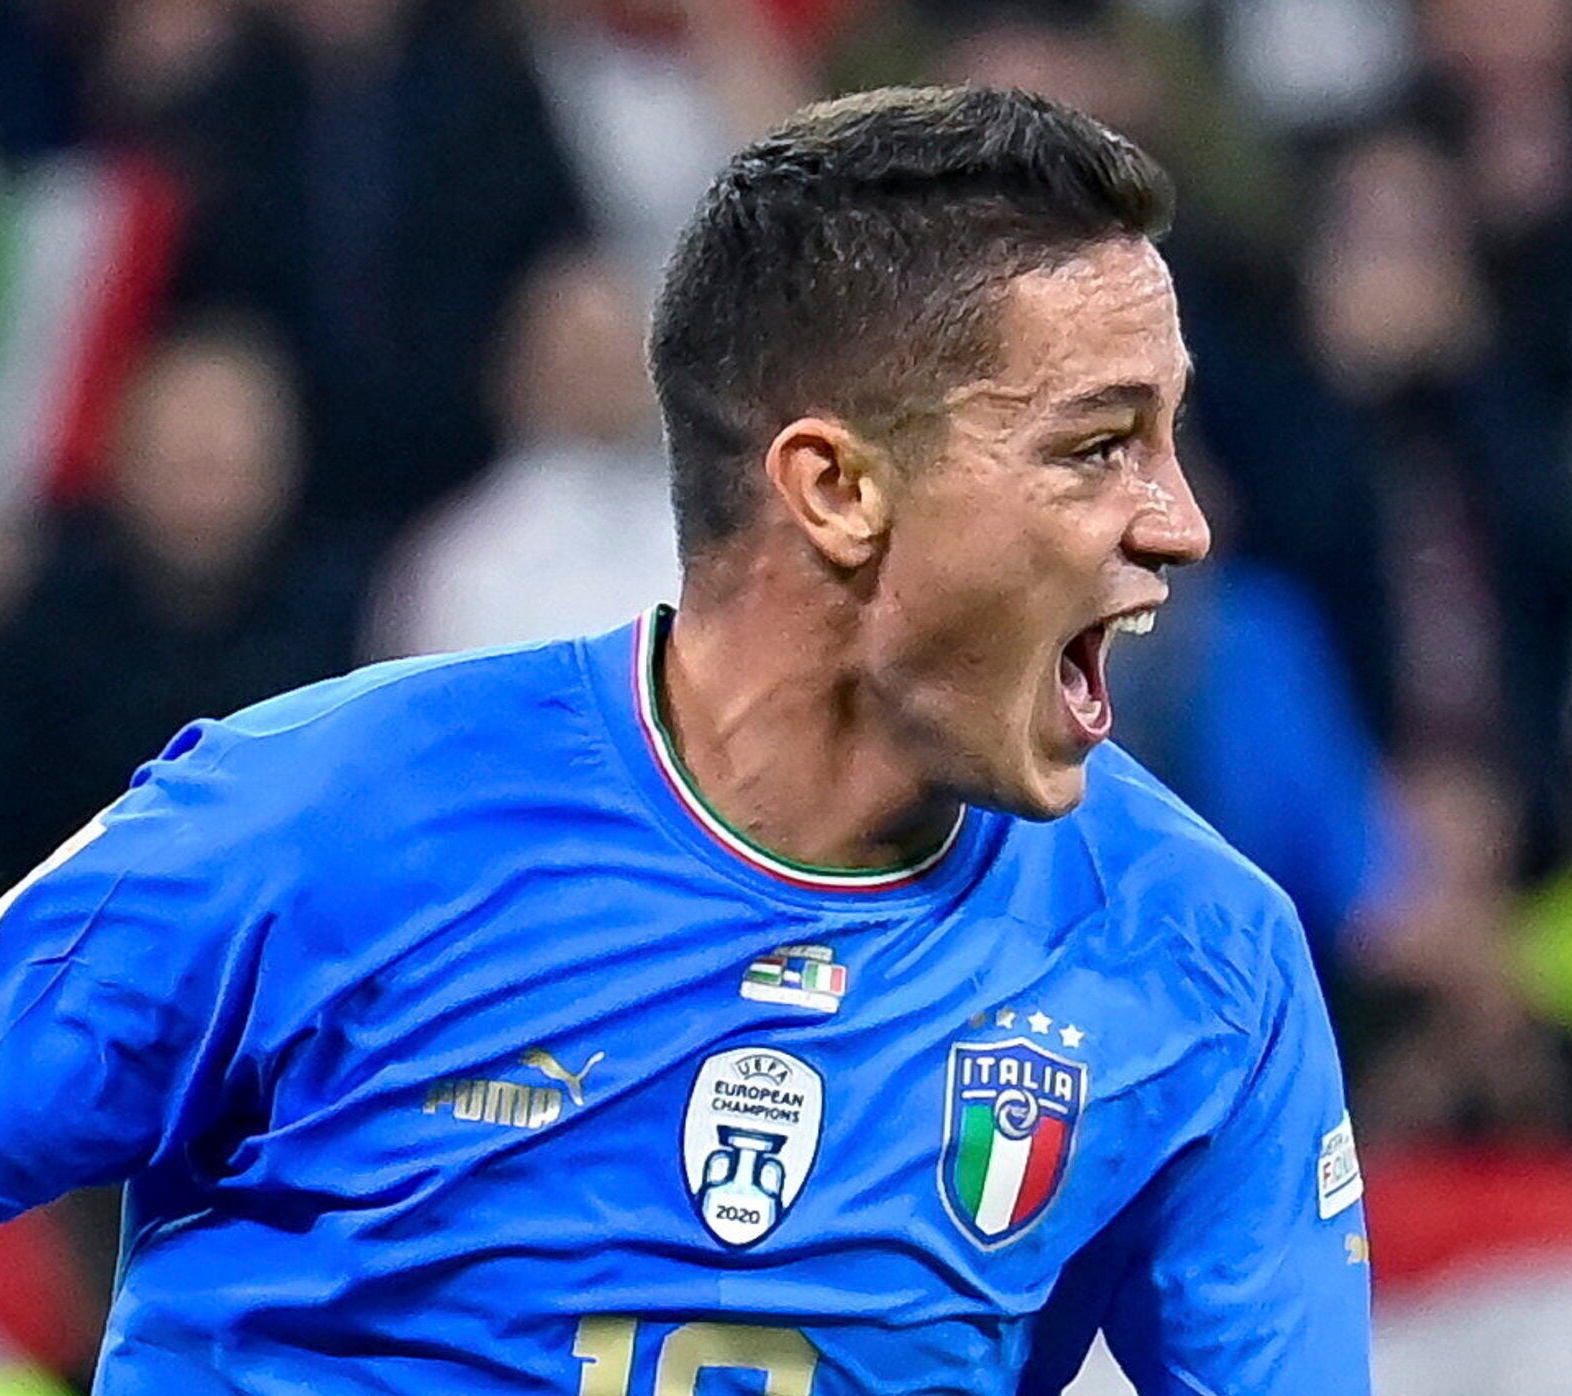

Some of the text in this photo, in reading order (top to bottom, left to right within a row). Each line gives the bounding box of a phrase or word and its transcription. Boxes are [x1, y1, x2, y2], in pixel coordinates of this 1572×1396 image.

[737, 1058, 790, 1084] UEFA
[962, 1056, 1073, 1102] ITALIA
[714, 1079, 805, 1107] EUROPEAN
[711, 1096, 802, 1125] CHAMPIONS
[715, 1204, 762, 1225] 2020
